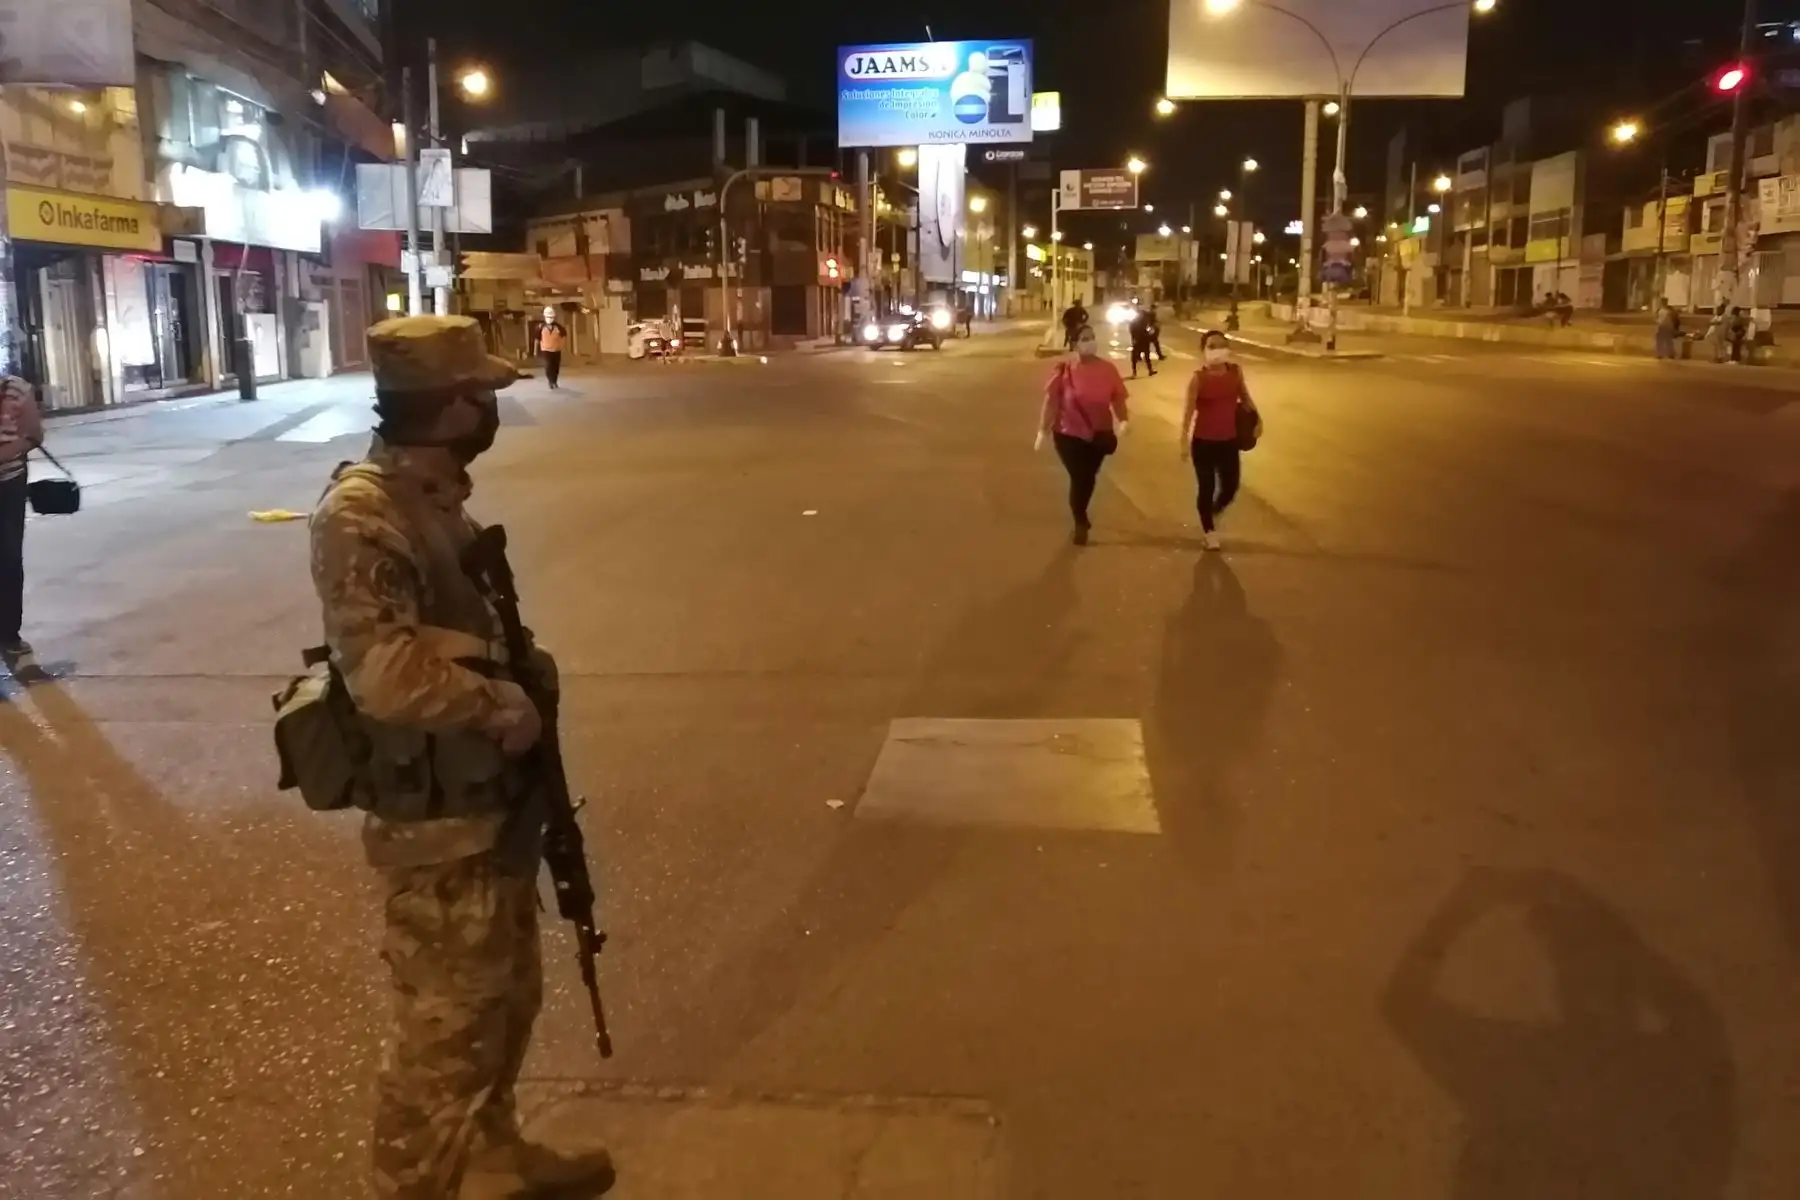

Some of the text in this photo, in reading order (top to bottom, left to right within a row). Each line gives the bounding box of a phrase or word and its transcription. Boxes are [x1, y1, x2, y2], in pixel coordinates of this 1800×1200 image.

[905, 110, 928, 120] Color
[928, 128, 1012, 139] KONICA MINOLTA
[56, 202, 140, 235] Inkafarma
